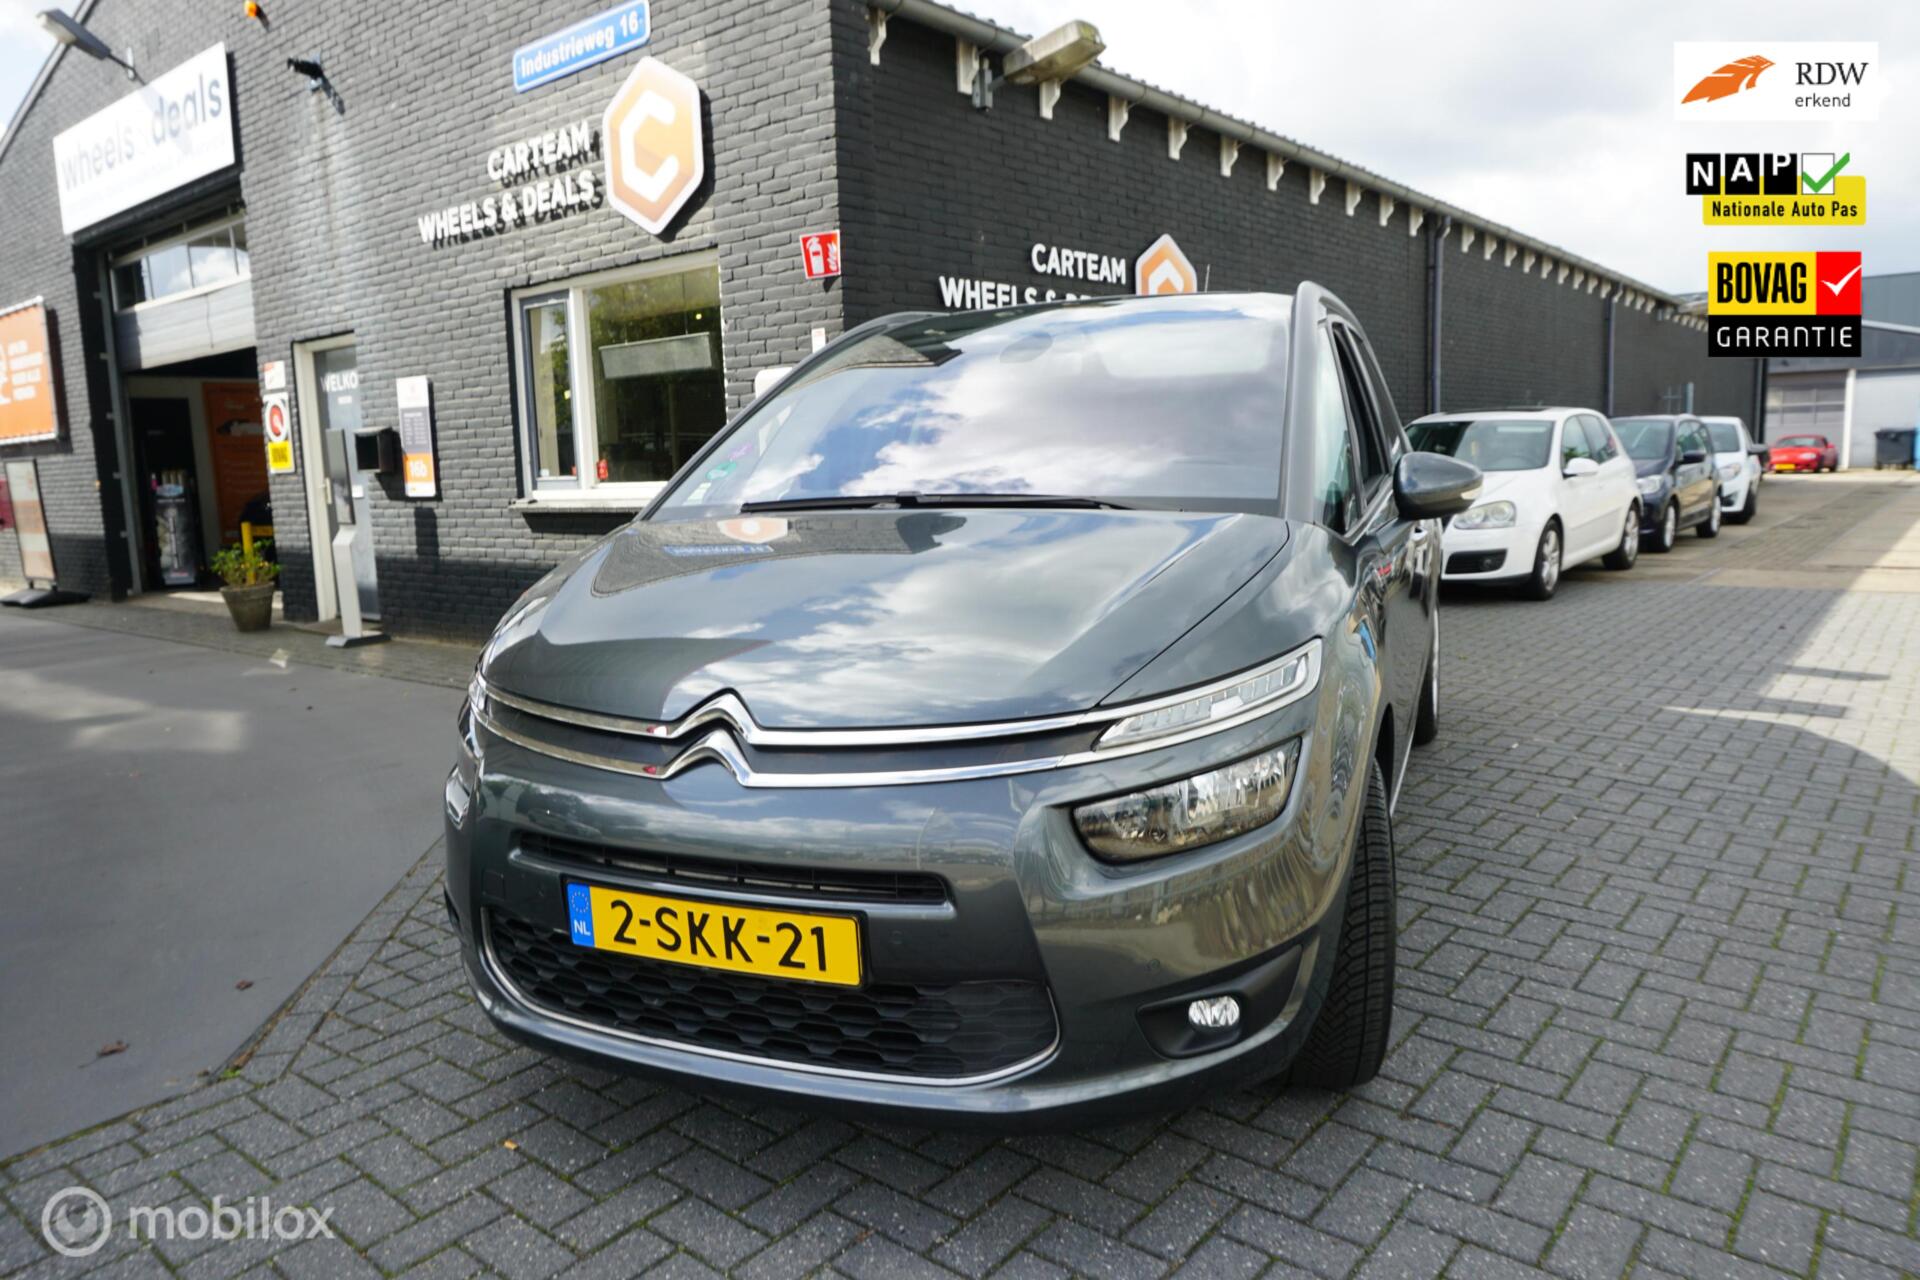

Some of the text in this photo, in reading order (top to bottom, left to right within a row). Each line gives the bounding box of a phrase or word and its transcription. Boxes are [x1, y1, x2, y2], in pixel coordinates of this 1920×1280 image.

[521, 10, 639, 78] Industrieweg 16
[152, 73, 222, 146] deals
[487, 121, 590, 180] CARTEAM
[418, 170, 595, 243] WHEELS & DEALS
[939, 276, 1037, 310] WHEELS
[1031, 243, 1126, 285] CARTEAM
[574, 920, 590, 936] NL
[610, 899, 827, 972] 2-SKK-21
